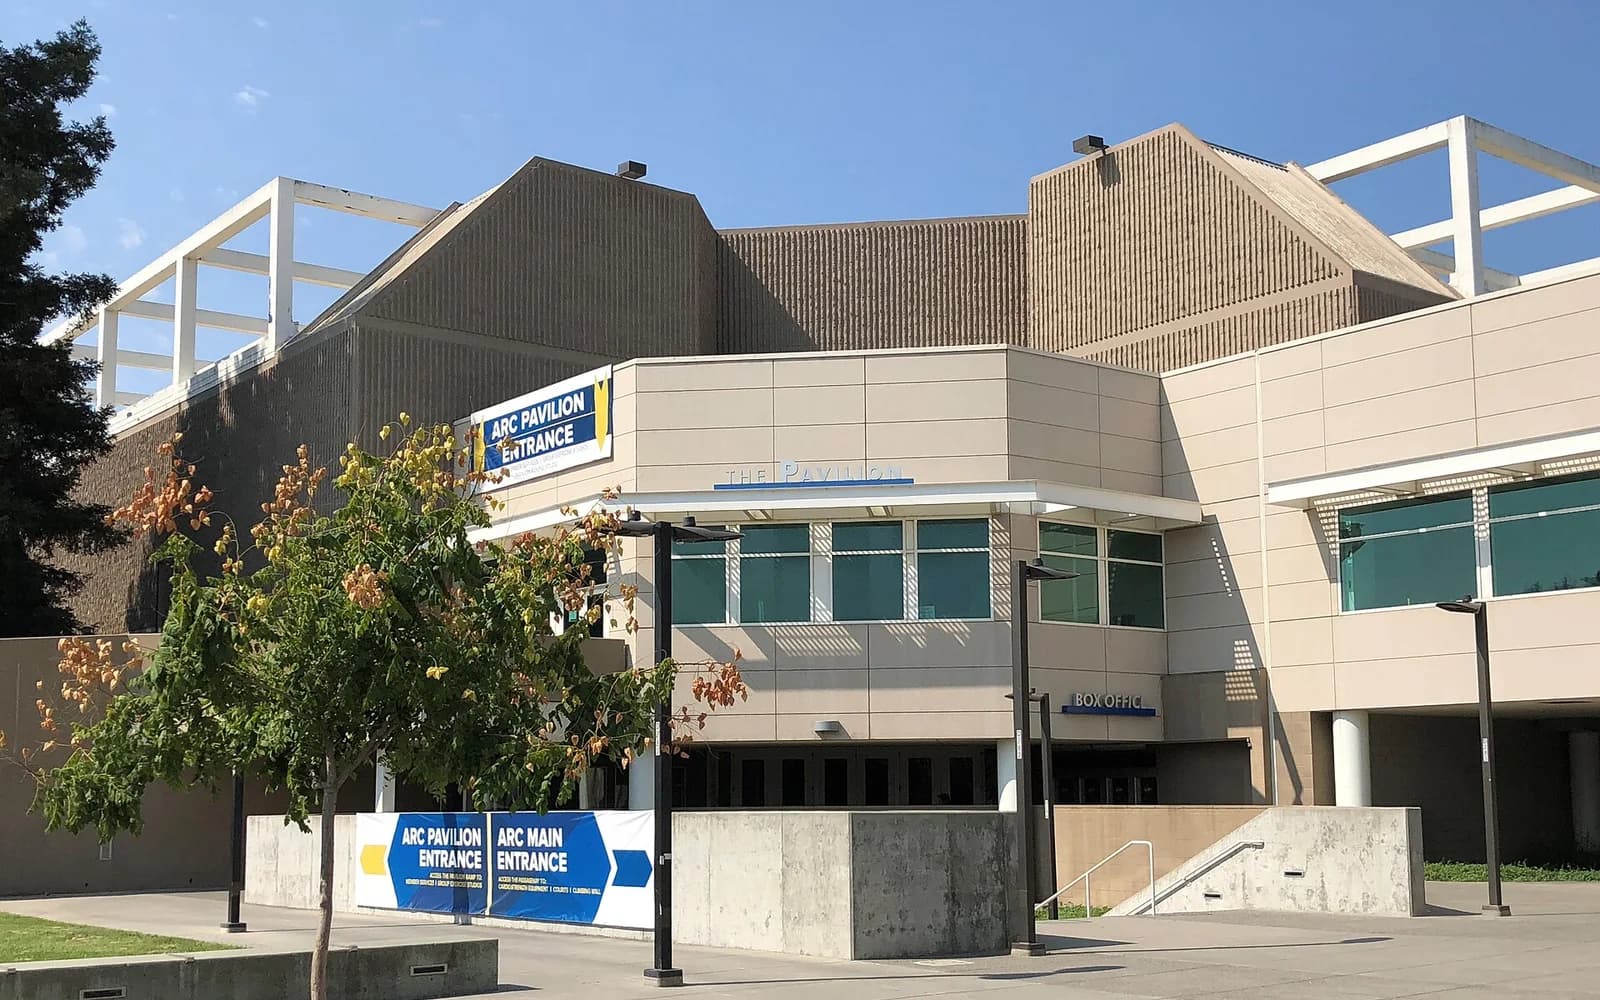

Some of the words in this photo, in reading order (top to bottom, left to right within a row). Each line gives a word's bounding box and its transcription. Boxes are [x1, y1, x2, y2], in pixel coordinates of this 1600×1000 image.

[491, 414, 518, 440] ARC
[521, 391, 585, 431] PAVILION
[502, 424, 574, 464] ENTRANCE
[726, 469, 766, 485] THE
[781, 459, 904, 484] PAVILION
[1075, 693, 1101, 708] BOX
[402, 827, 425, 845] ARC
[428, 827, 482, 847] PAVILION
[497, 827, 524, 847] ARC
[527, 827, 563, 847] MAIN
[419, 849, 482, 869] ENTRANCE
[497, 851, 567, 872] ENTRANCE
